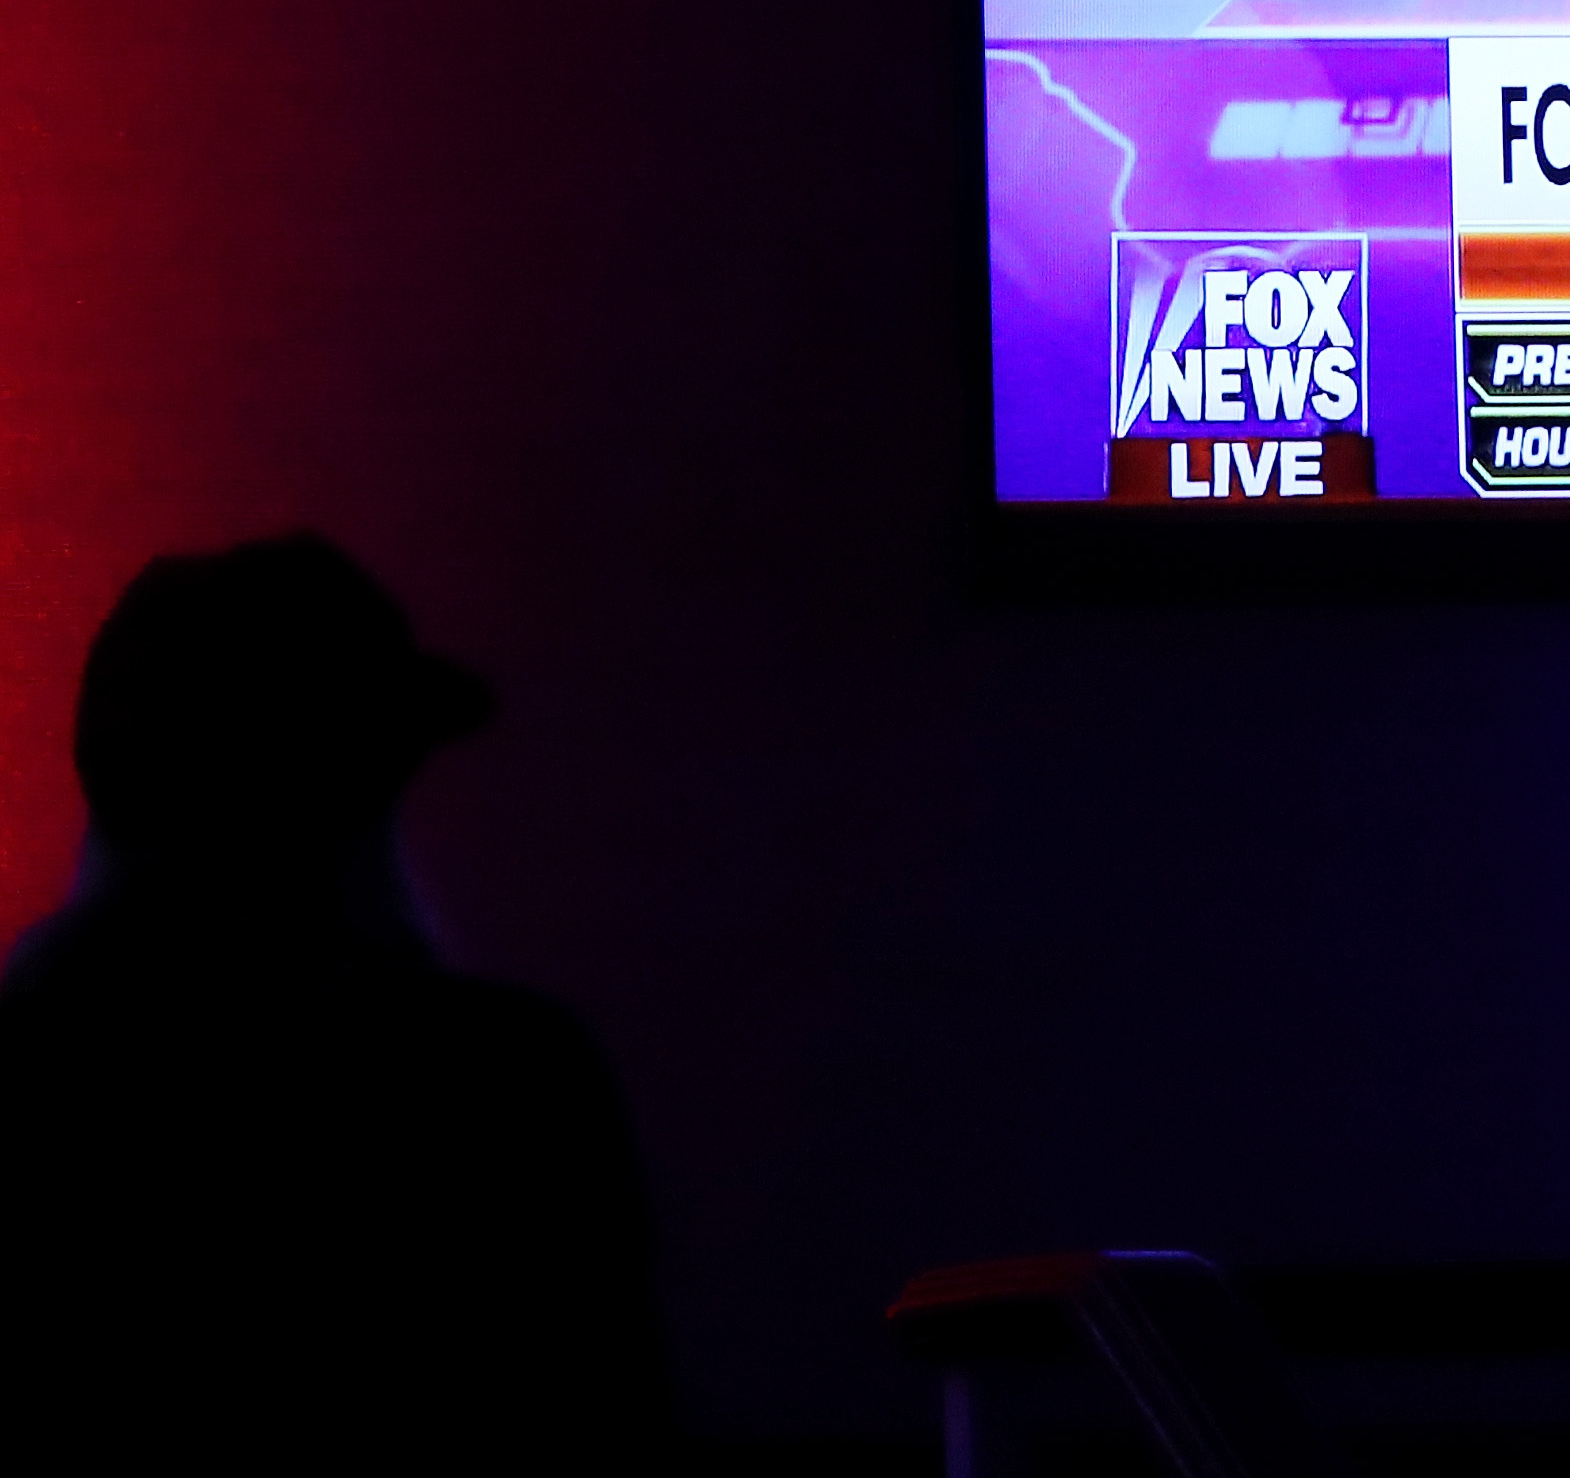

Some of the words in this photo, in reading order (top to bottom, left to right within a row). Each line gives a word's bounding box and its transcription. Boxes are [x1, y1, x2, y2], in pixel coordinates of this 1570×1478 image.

[1204, 269, 1354, 348] FOX
[1150, 347, 1358, 422] NEWS
[1169, 441, 1325, 498] LIVE
